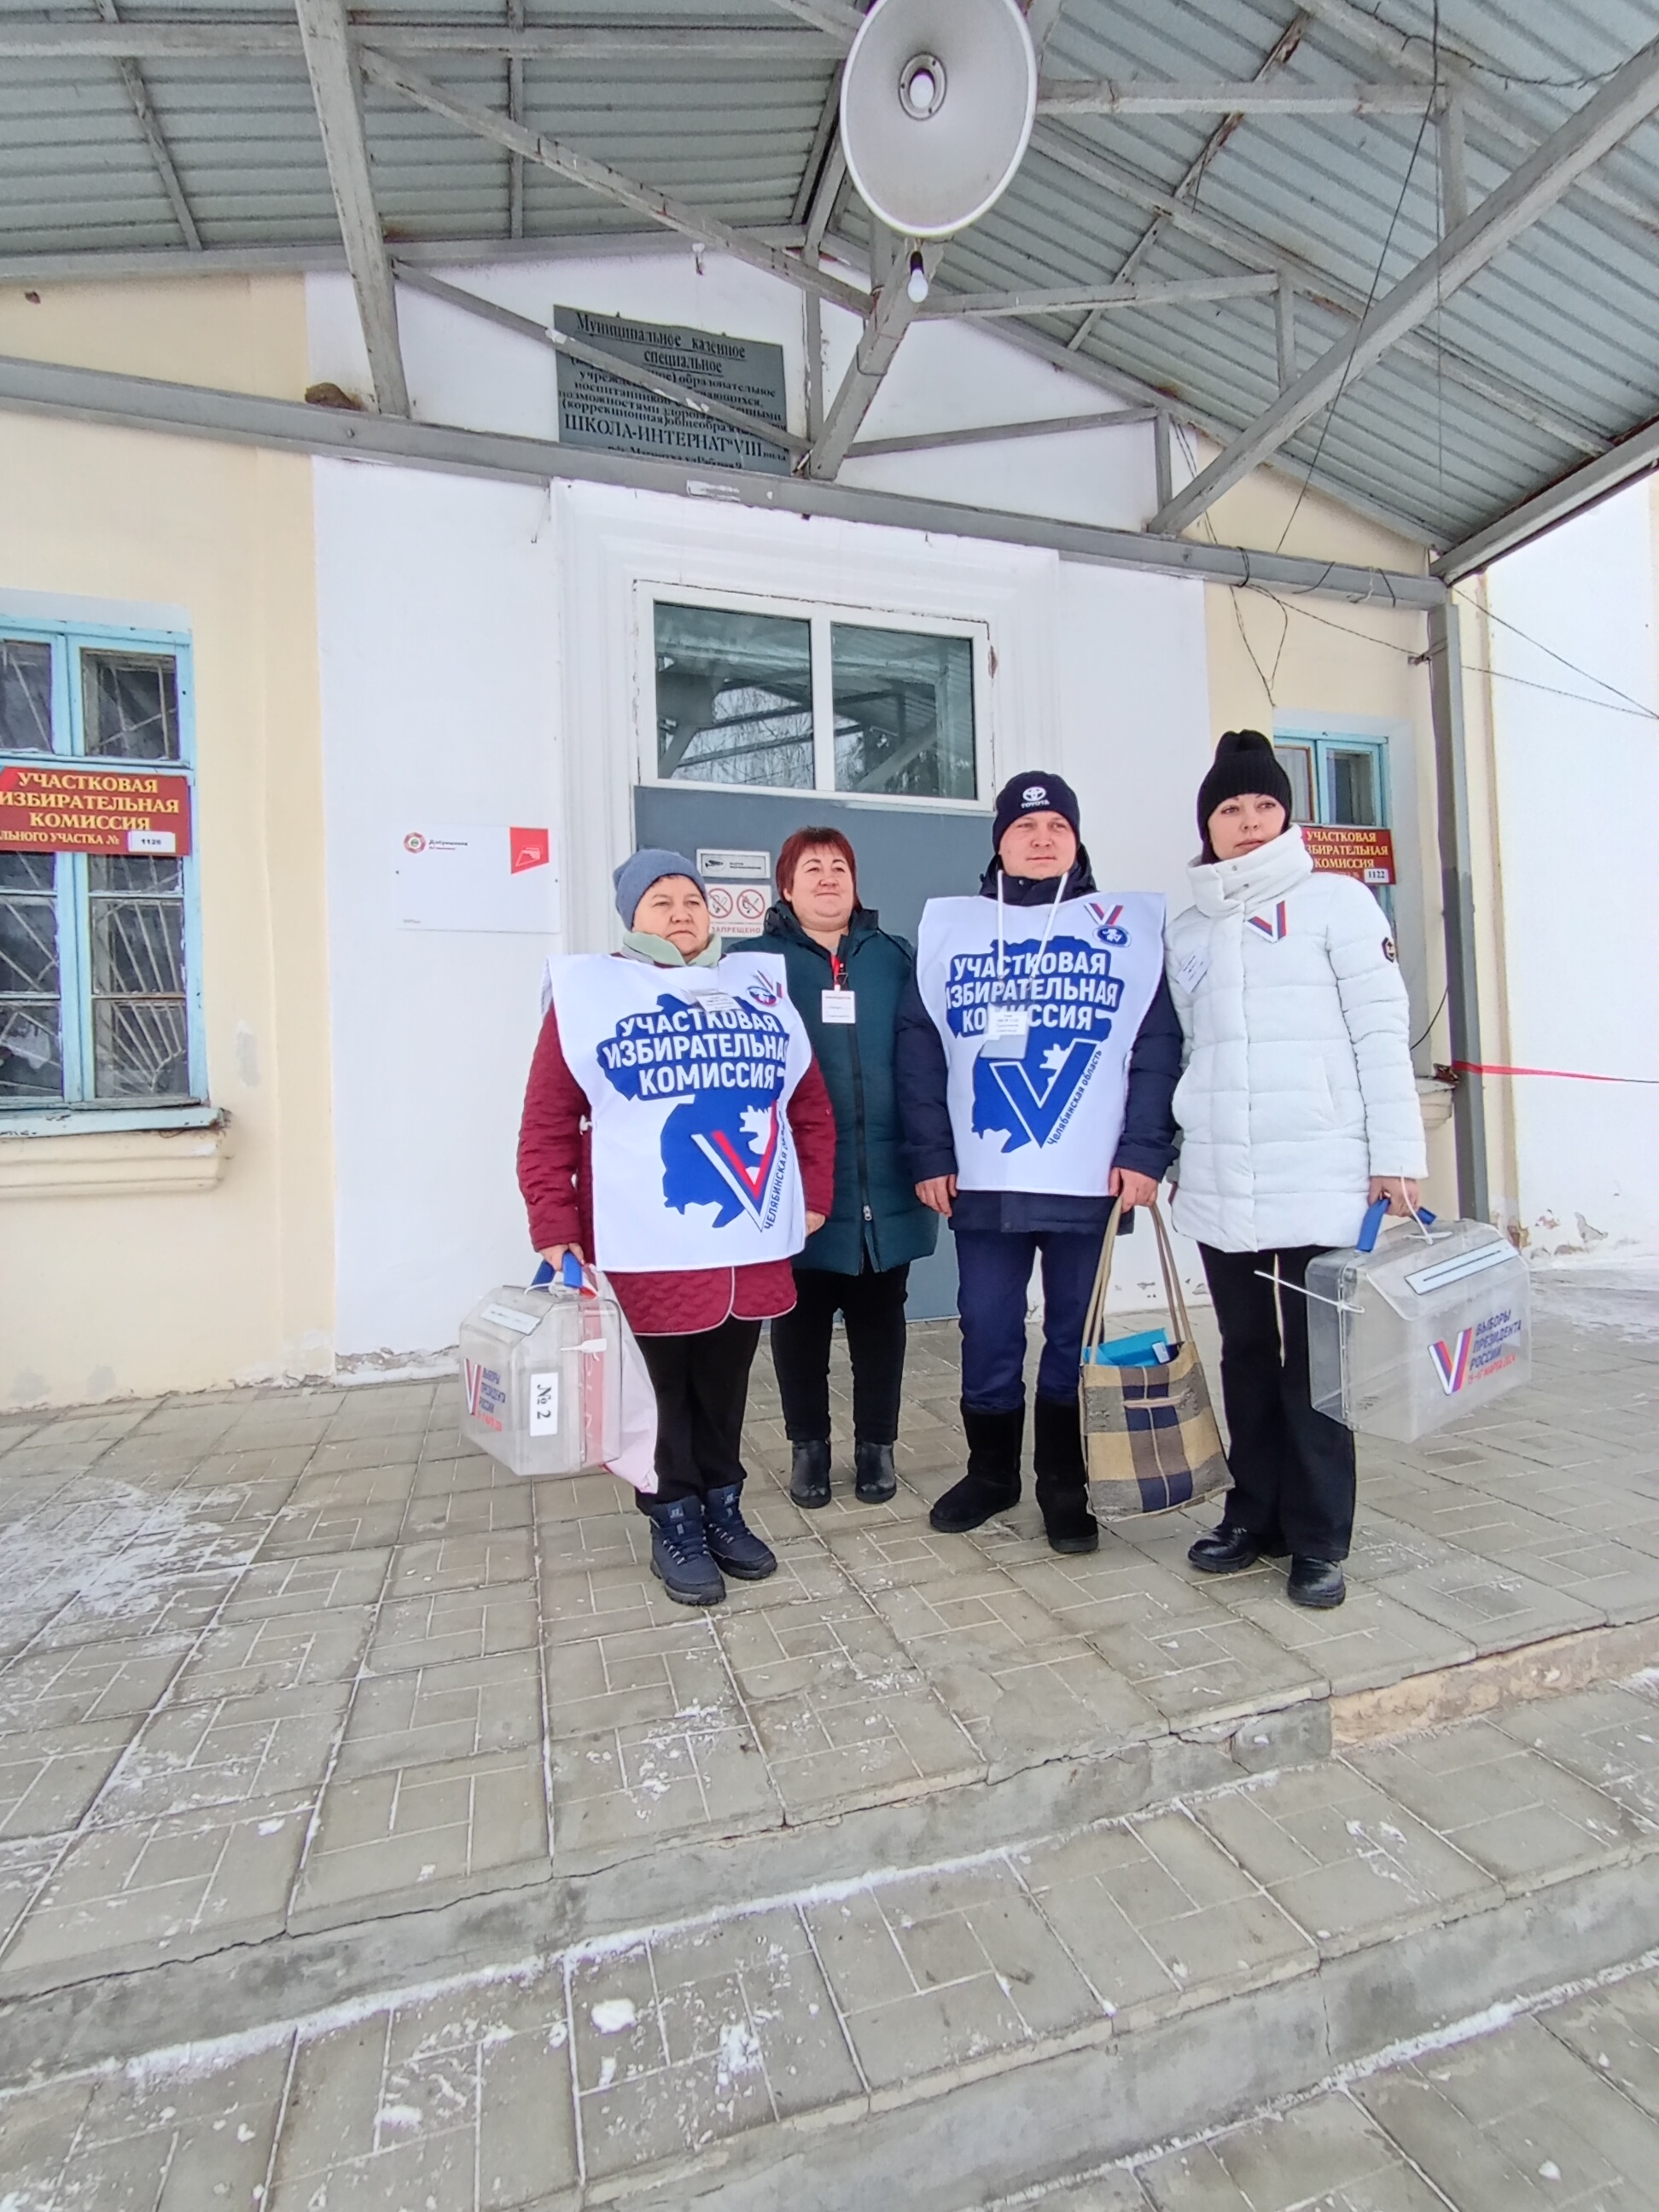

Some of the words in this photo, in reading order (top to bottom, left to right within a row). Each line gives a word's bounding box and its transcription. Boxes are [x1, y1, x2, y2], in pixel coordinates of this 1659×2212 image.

[575, 312, 681, 346] Муниципальное
[643, 350, 722, 373] специальное
[18, 772, 159, 794] УЧАСТКОВАЯ
[0, 791, 179, 813] ИЗБИРАТЕЛЬНАЯ
[1020, 799, 1050, 808] TOYOTA
[30, 812, 150, 830] КОМИССИЯ
[50, 832, 104, 845] УЧАСТКА
[1306, 831, 1377, 842] УЧАСТКОВАЯ
[1306, 845, 1388, 856] ЗБИРАТЕЛЬНАЯ
[1314, 859, 1374, 868] КОМИССИЯ
[1368, 870, 1385, 879] 1122
[954, 951, 1107, 981] УЧАСТКОВАЯ
[620, 1010, 780, 1038] УЧАСТКОВАЯ
[963, 1004, 1092, 1033] КОССИЯ
[638, 1062, 776, 1097] КОМИССИЯ
[1047, 1086, 1085, 1146] Челябинская
[1081, 1049, 1103, 1086] область
[764, 1152, 788, 1231] ЧЕЛЯБИНСКАЯ
[1476, 1309, 1511, 1336] ВЫБОРЫ
[1472, 1319, 1522, 1353] ПРЕЗИДЕНТА
[1470, 1345, 1503, 1371] РОССИИ
[537, 1409, 551, 1420] 2
